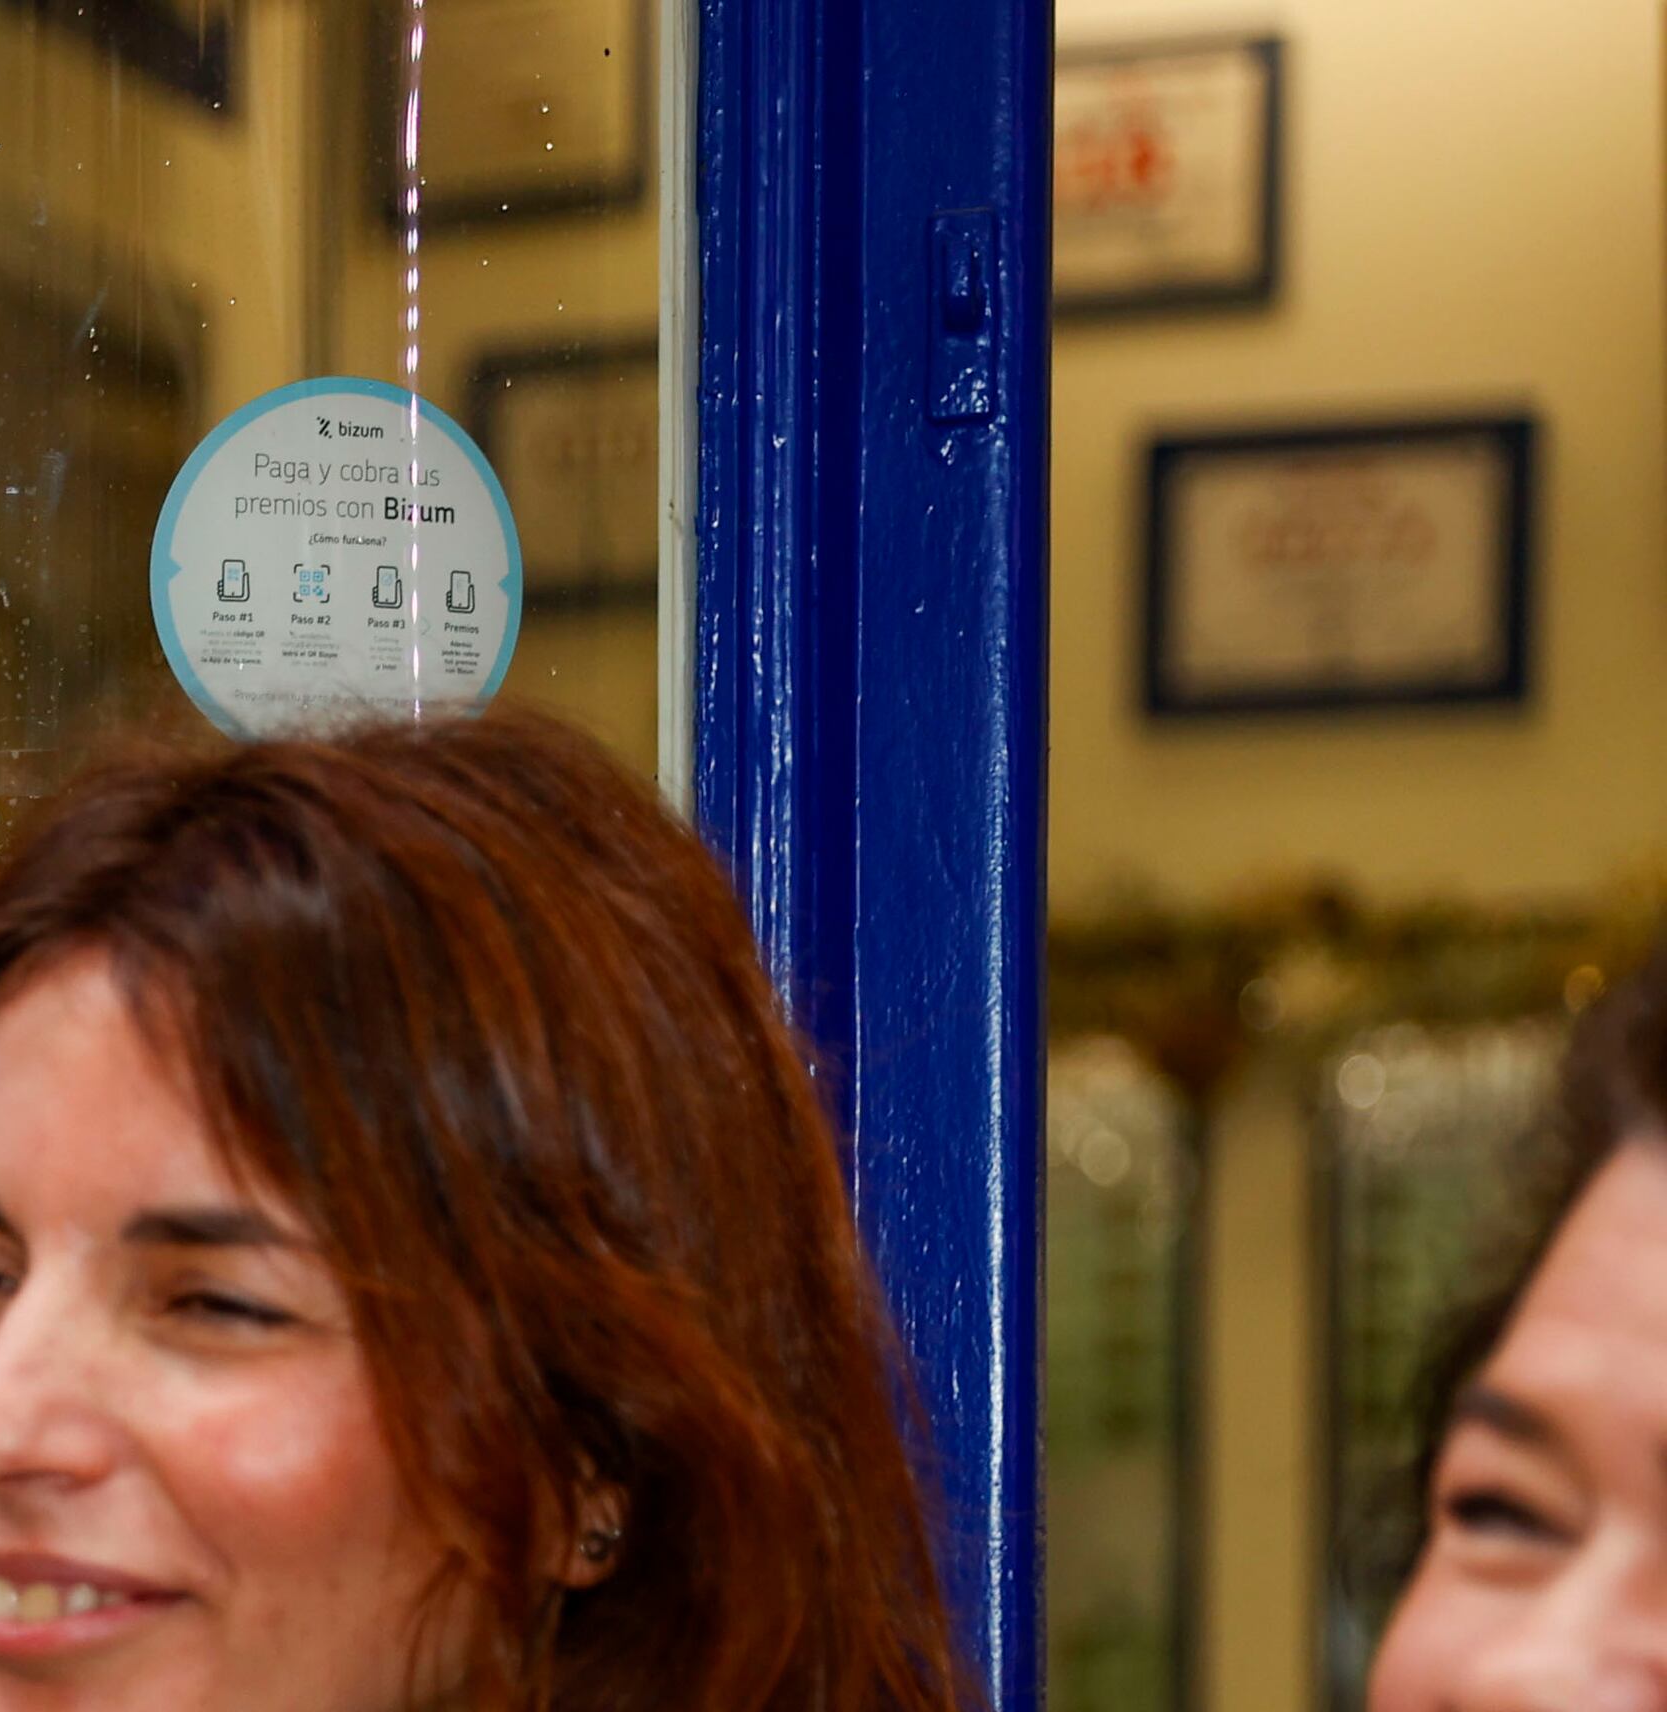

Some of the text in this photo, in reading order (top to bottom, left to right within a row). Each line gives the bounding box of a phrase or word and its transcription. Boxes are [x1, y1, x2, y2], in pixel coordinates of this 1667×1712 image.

[338, 421, 385, 440] bizum
[253, 452, 441, 488] Paga y cobra tus
[234, 492, 456, 525] premios con Bizum
[212, 611, 253, 623] Paso #1
[290, 614, 331, 626] Paso #2
[367, 618, 390, 629] Paso
[444, 622, 479, 635] Premios
